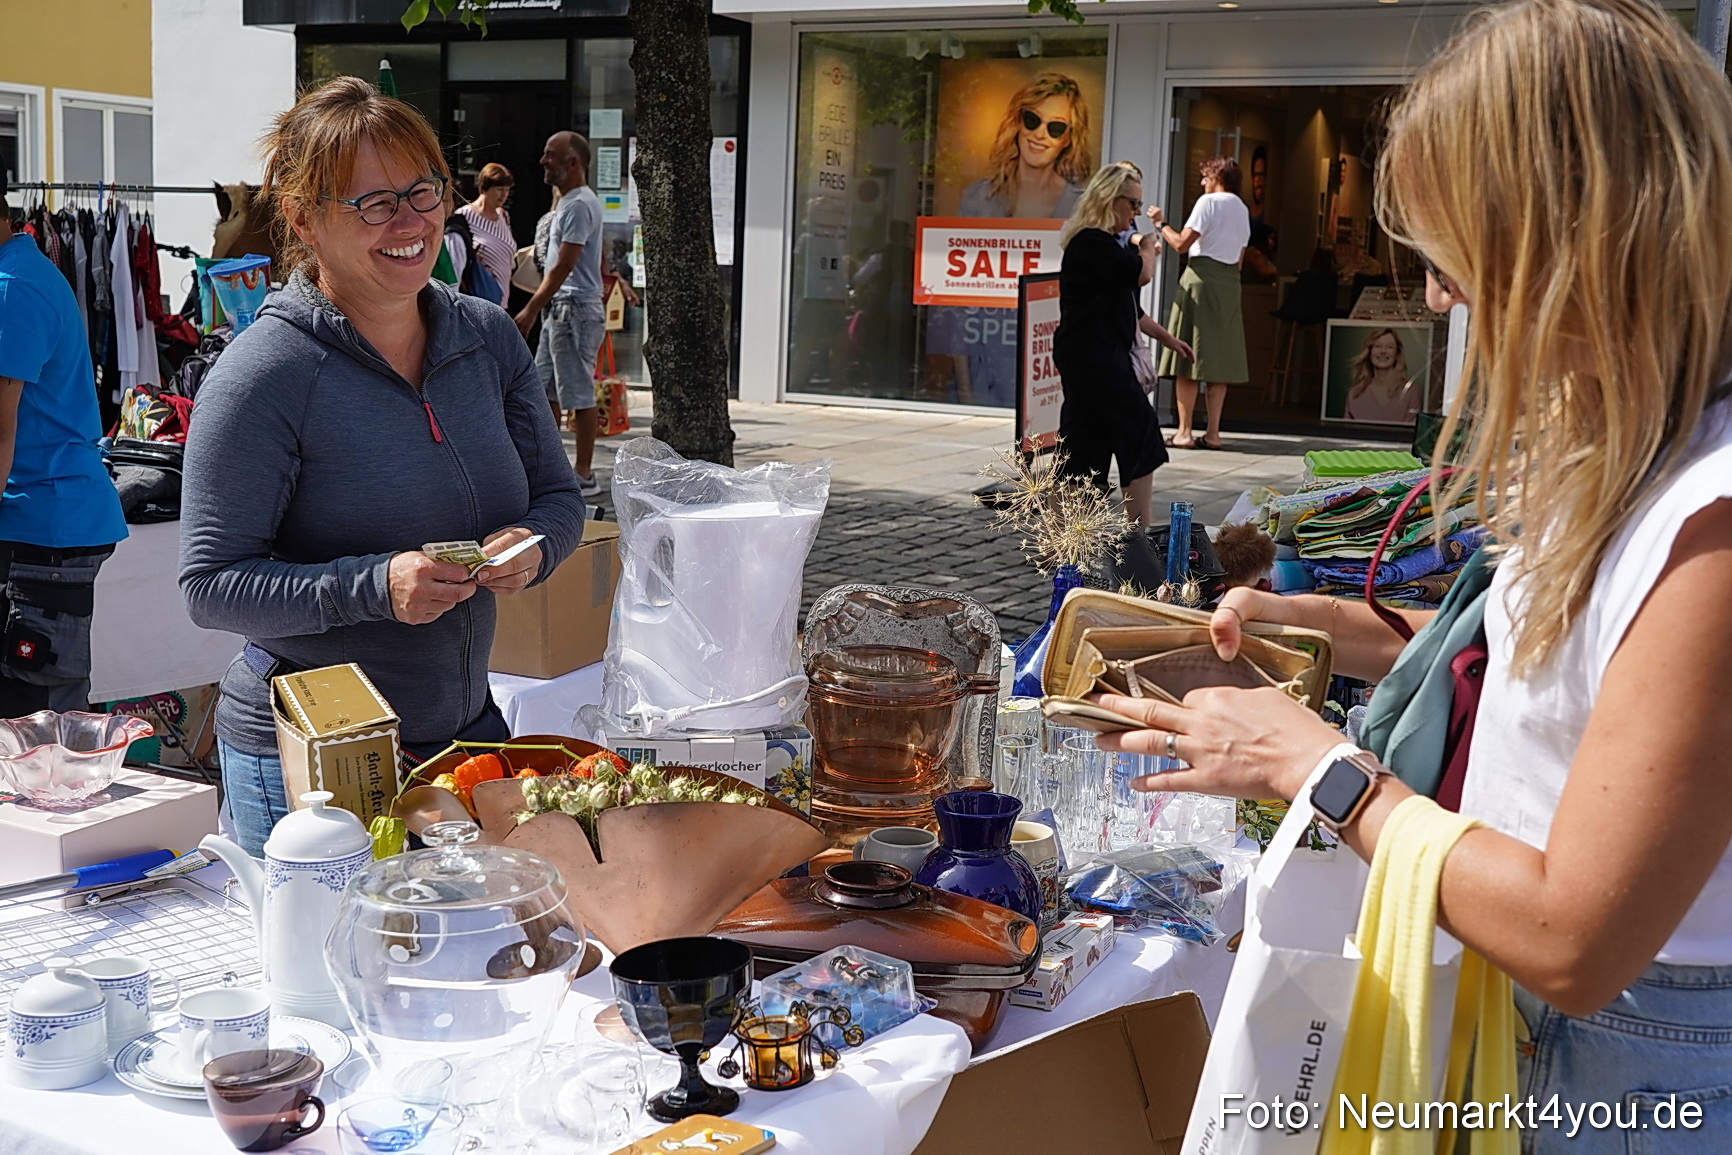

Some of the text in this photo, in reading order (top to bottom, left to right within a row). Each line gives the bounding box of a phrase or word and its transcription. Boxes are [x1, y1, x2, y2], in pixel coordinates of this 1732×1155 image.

[824, 103, 847, 124] JEDE
[819, 124, 850, 147] BRILLE
[826, 149, 842, 167] EIN
[819, 171, 846, 191] PREIS
[947, 237, 1042, 250] SONNENBRILLEN
[946, 248, 1042, 279] SALE
[944, 279, 1006, 290] Sonnenbrillen
[1032, 338, 1054, 356] BRIL
